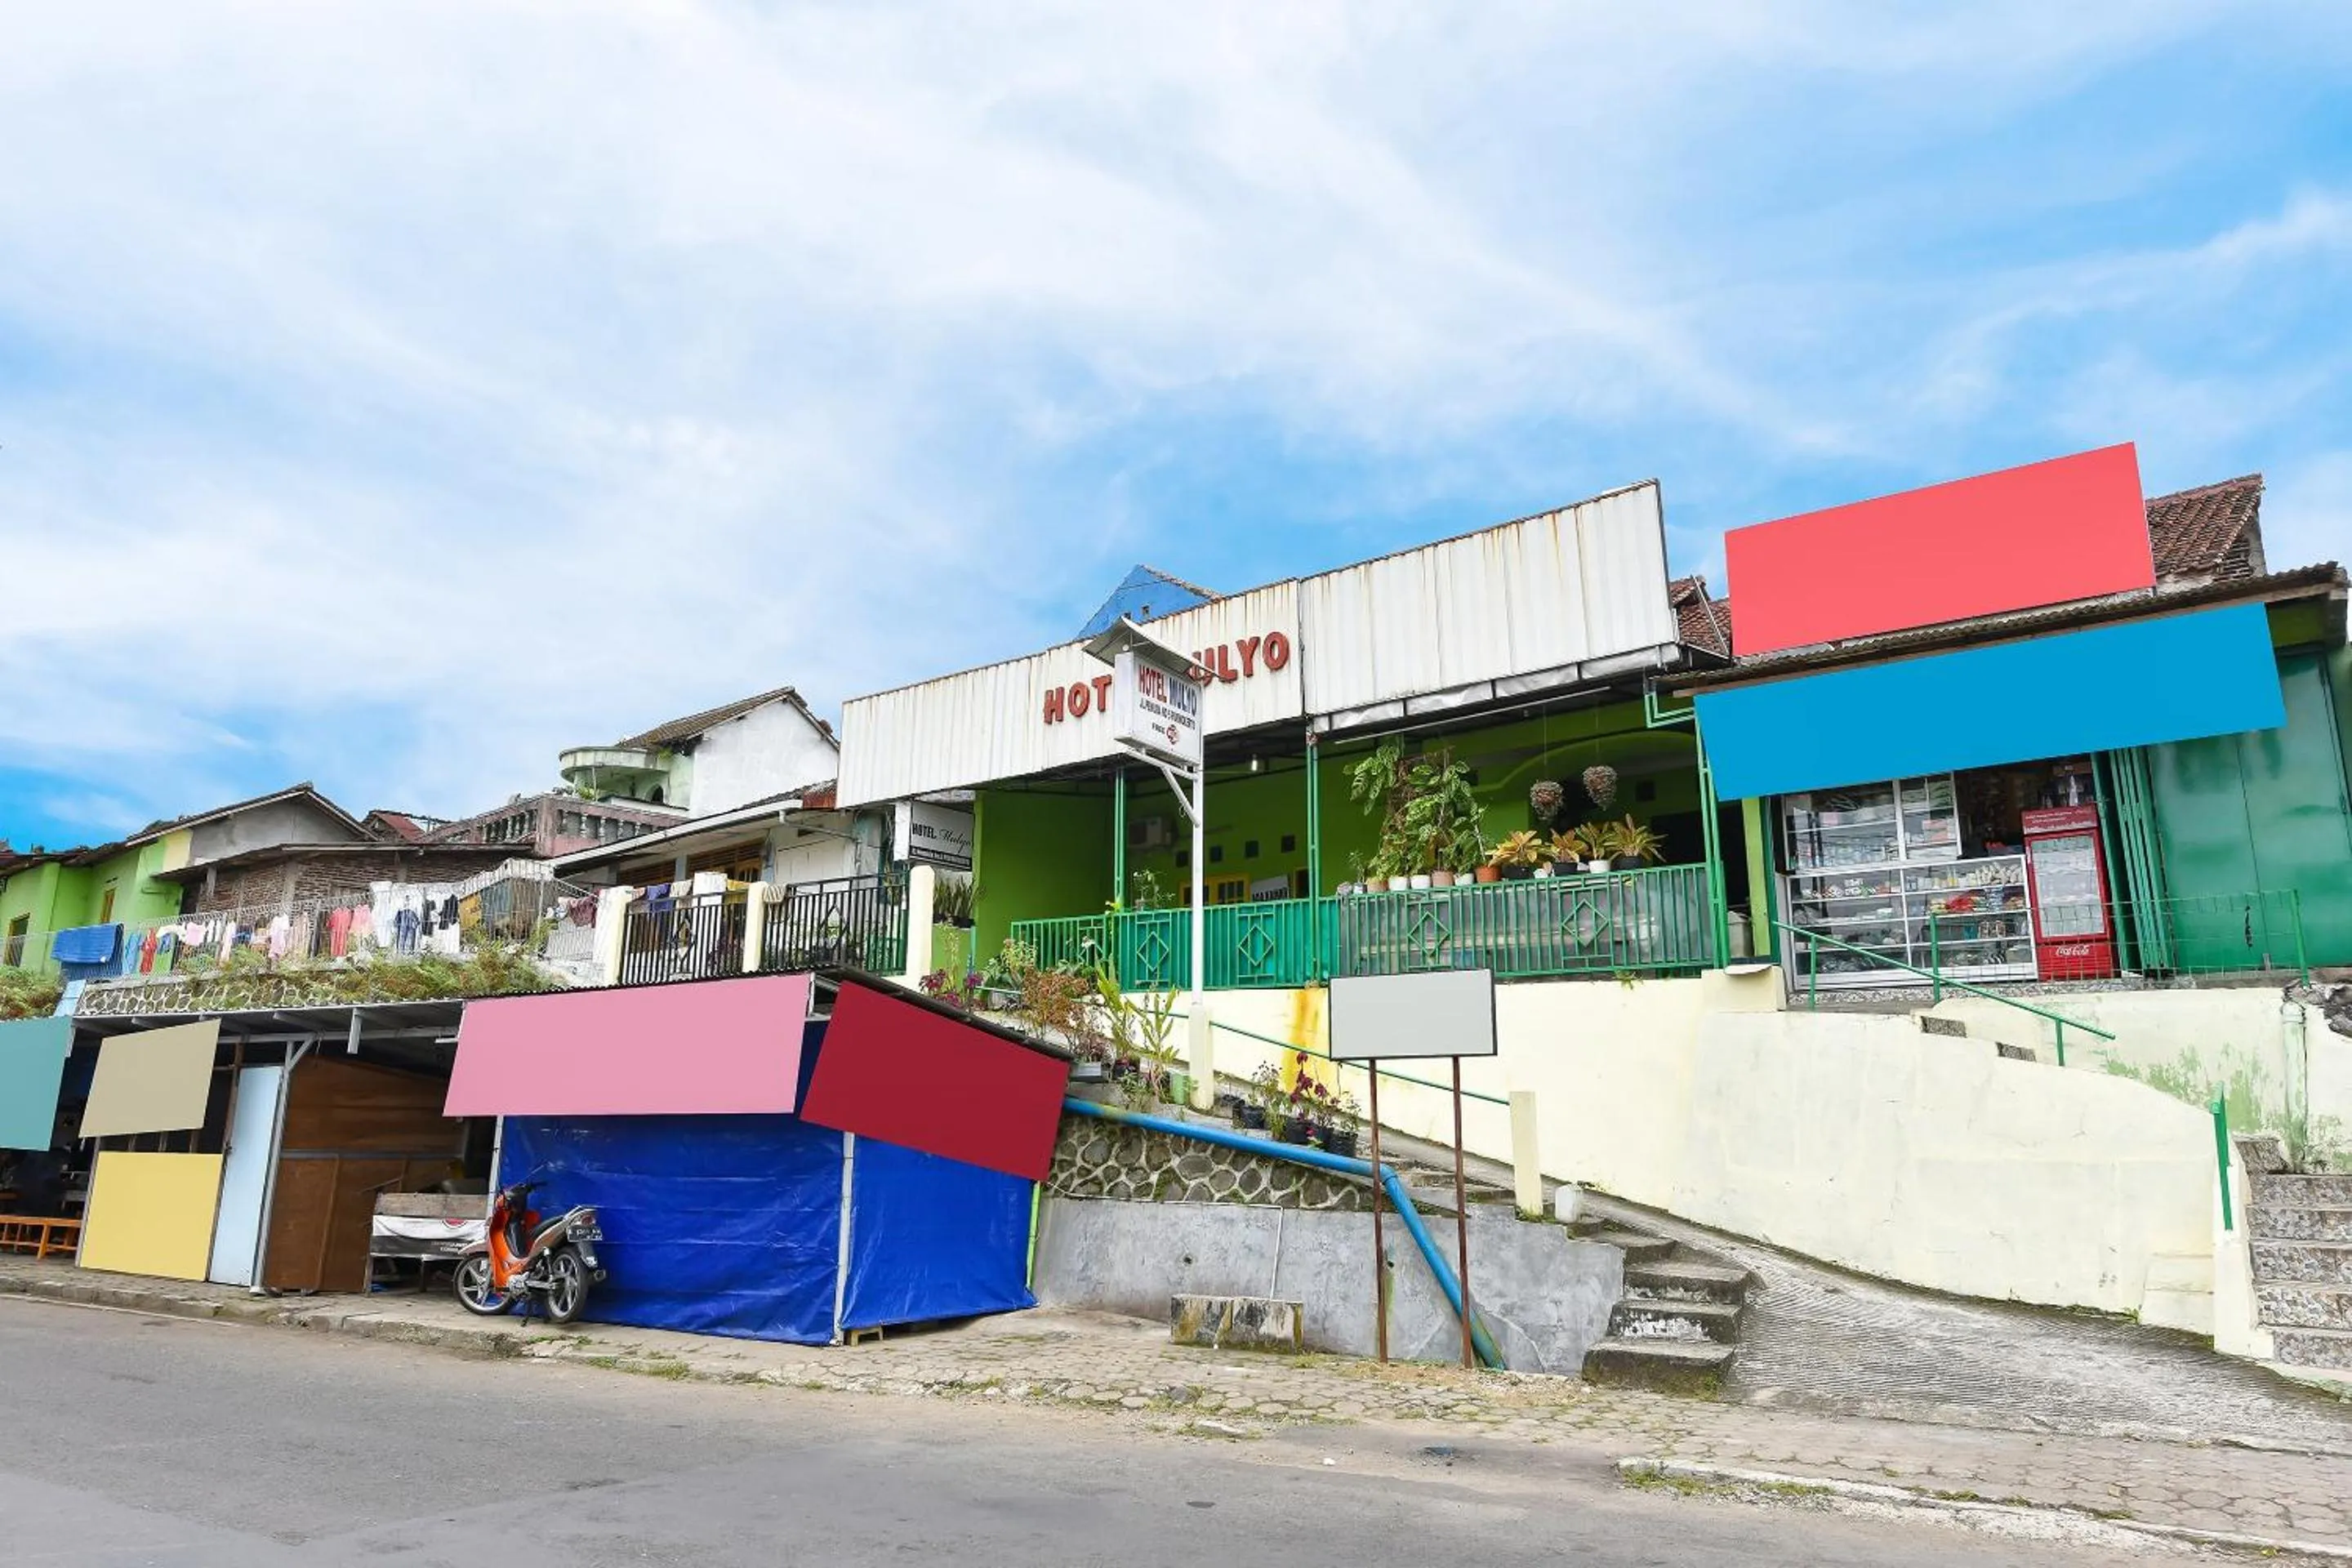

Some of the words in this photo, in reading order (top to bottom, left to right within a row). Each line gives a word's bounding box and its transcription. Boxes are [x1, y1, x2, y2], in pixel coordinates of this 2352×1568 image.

[1044, 675, 1112, 725] HOT
[1185, 631, 1290, 687] ULYO
[1139, 663, 1167, 703] HOTEL
[912, 822, 937, 840] HOTEL
